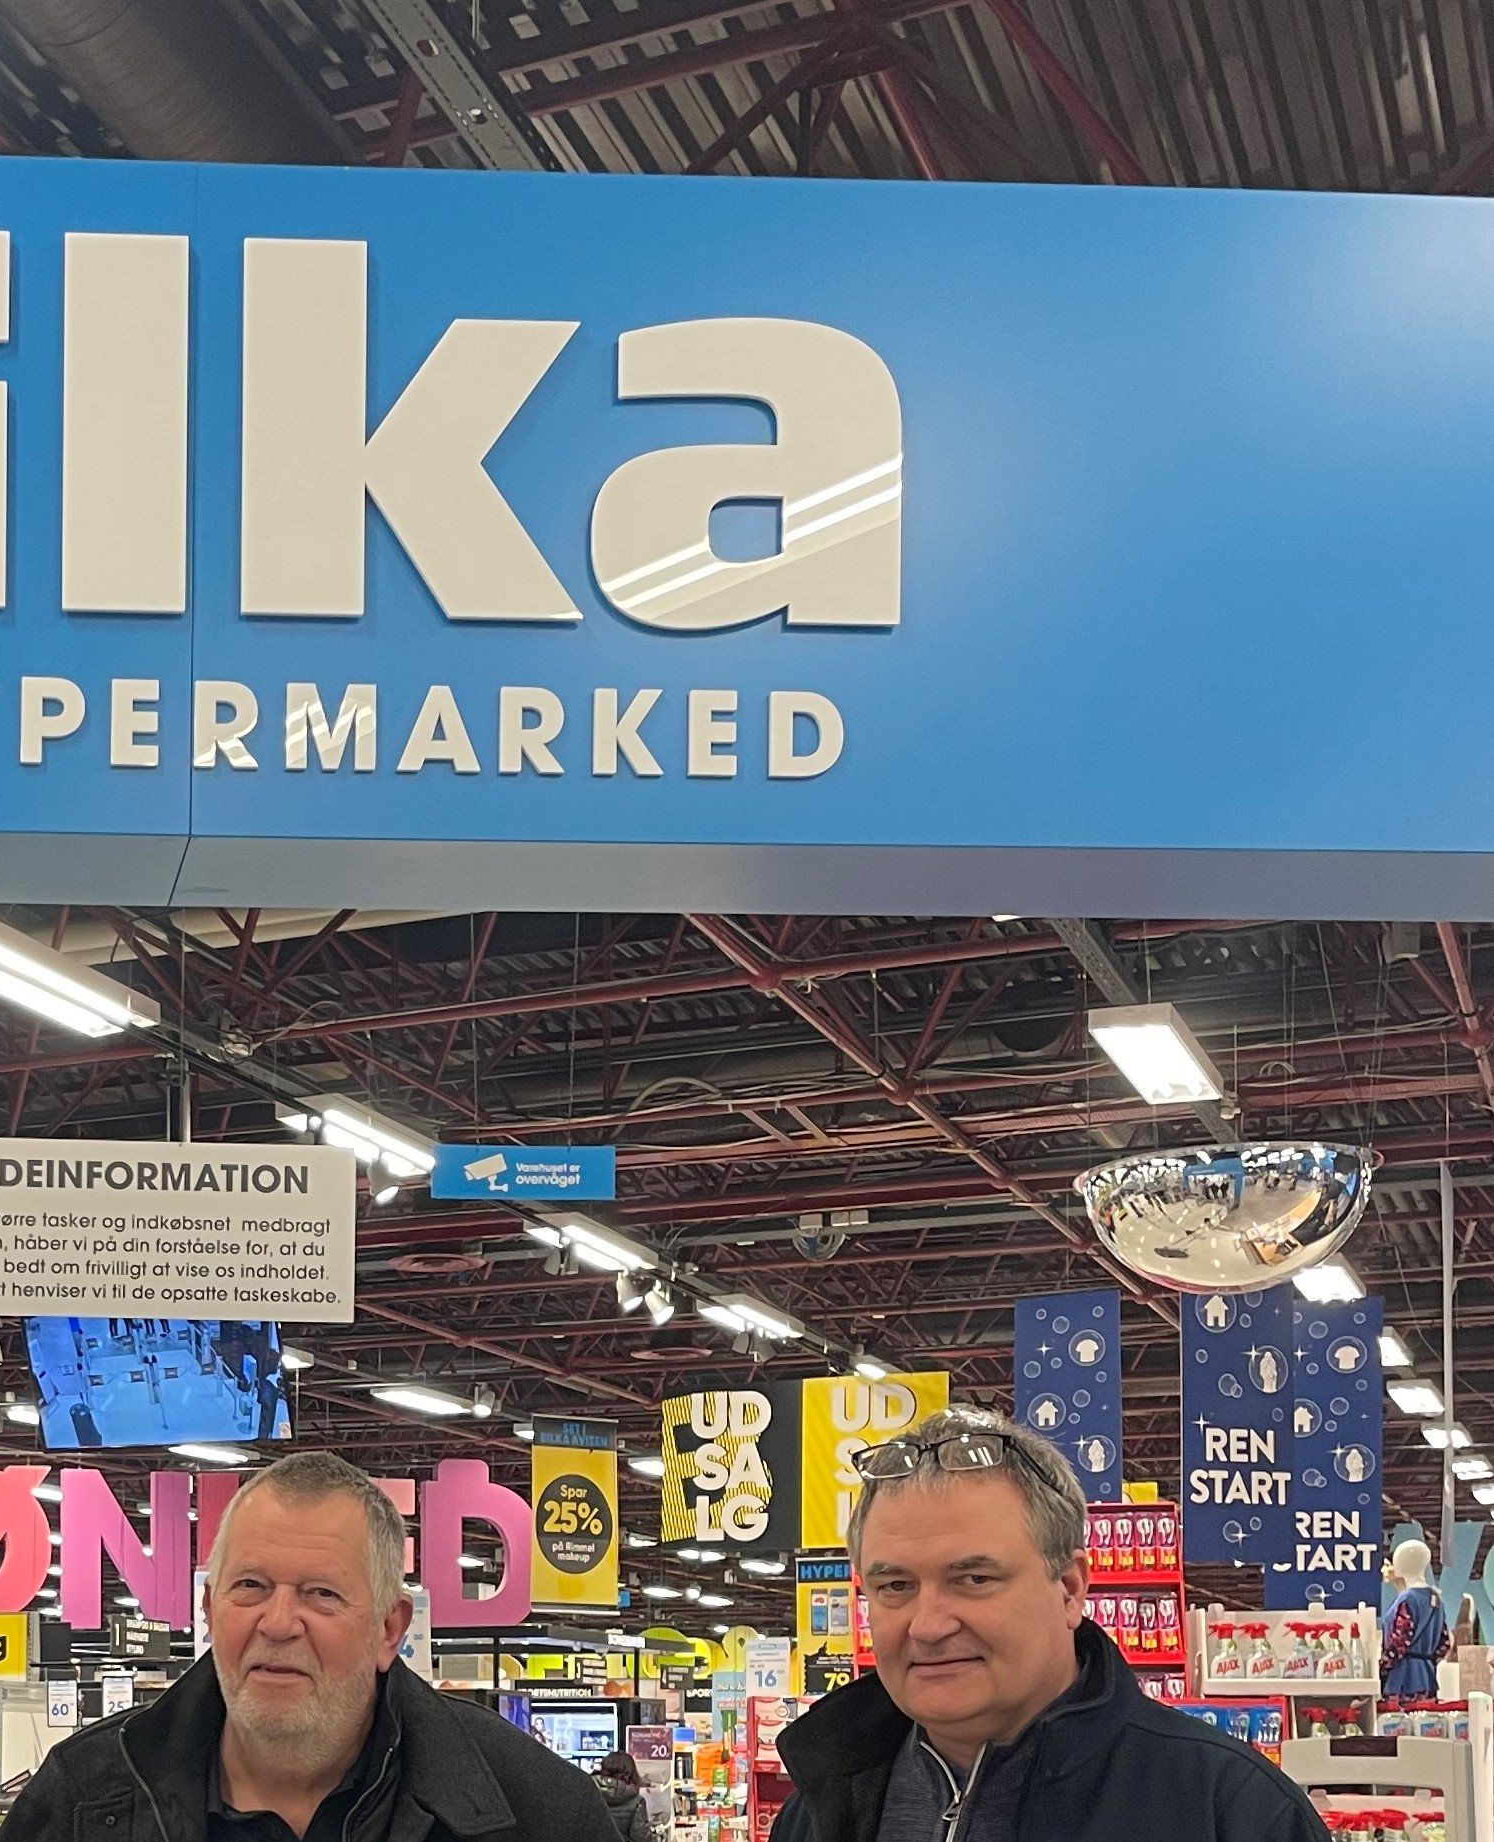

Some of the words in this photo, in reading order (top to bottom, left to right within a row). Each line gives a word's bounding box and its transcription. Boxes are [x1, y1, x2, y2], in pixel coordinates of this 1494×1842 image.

[515, 1172, 581, 1188] overvåget
[42, 1212, 97, 1228] tasker
[102, 1216, 126, 1232] og
[131, 1214, 231, 1231] indkøbsnet
[241, 1217, 331, 1237] medbragt
[14, 1234, 68, 1251] håber
[73, 1236, 87, 1251] vi
[93, 1236, 118, 1254] på
[123, 1238, 150, 1253] din
[156, 1238, 241, 1255] forståelse
[246, 1240, 274, 1257] for,
[279, 1242, 298, 1256] at
[302, 1242, 325, 1256] du
[4, 1258, 46, 1274] bedt
[51, 1261, 80, 1275] om
[85, 1260, 147, 1280] frivilligt
[152, 1263, 171, 1277] at
[175, 1262, 209, 1278] vise
[215, 1265, 235, 1278] os
[240, 1263, 330, 1280] indholdet.
[12, 1282, 87, 1298] henviser
[92, 1284, 107, 1298] vi
[112, 1283, 126, 1299] til
[132, 1284, 155, 1300] de
[161, 1286, 228, 1303] opsatte
[233, 1287, 341, 1304] taskeskabe.
[691, 1390, 772, 1439] UD
[832, 1384, 917, 1432] UD
[1206, 1428, 1275, 1464] REN
[692, 1442, 771, 1491] SA
[560, 1484, 588, 1500] Spar
[1190, 1469, 1291, 1505] START
[543, 1500, 603, 1535] 25%
[696, 1494, 769, 1542] LG
[1295, 1511, 1360, 1539] REN
[1272, 1544, 1377, 1572] TART
[1217, 1659, 1239, 1675] AJAX
[1252, 1657, 1274, 1675] AJAX
[1323, 1658, 1346, 1675] AJAX
[754, 1669, 777, 1688] 16
[51, 1703, 69, 1716] 60
